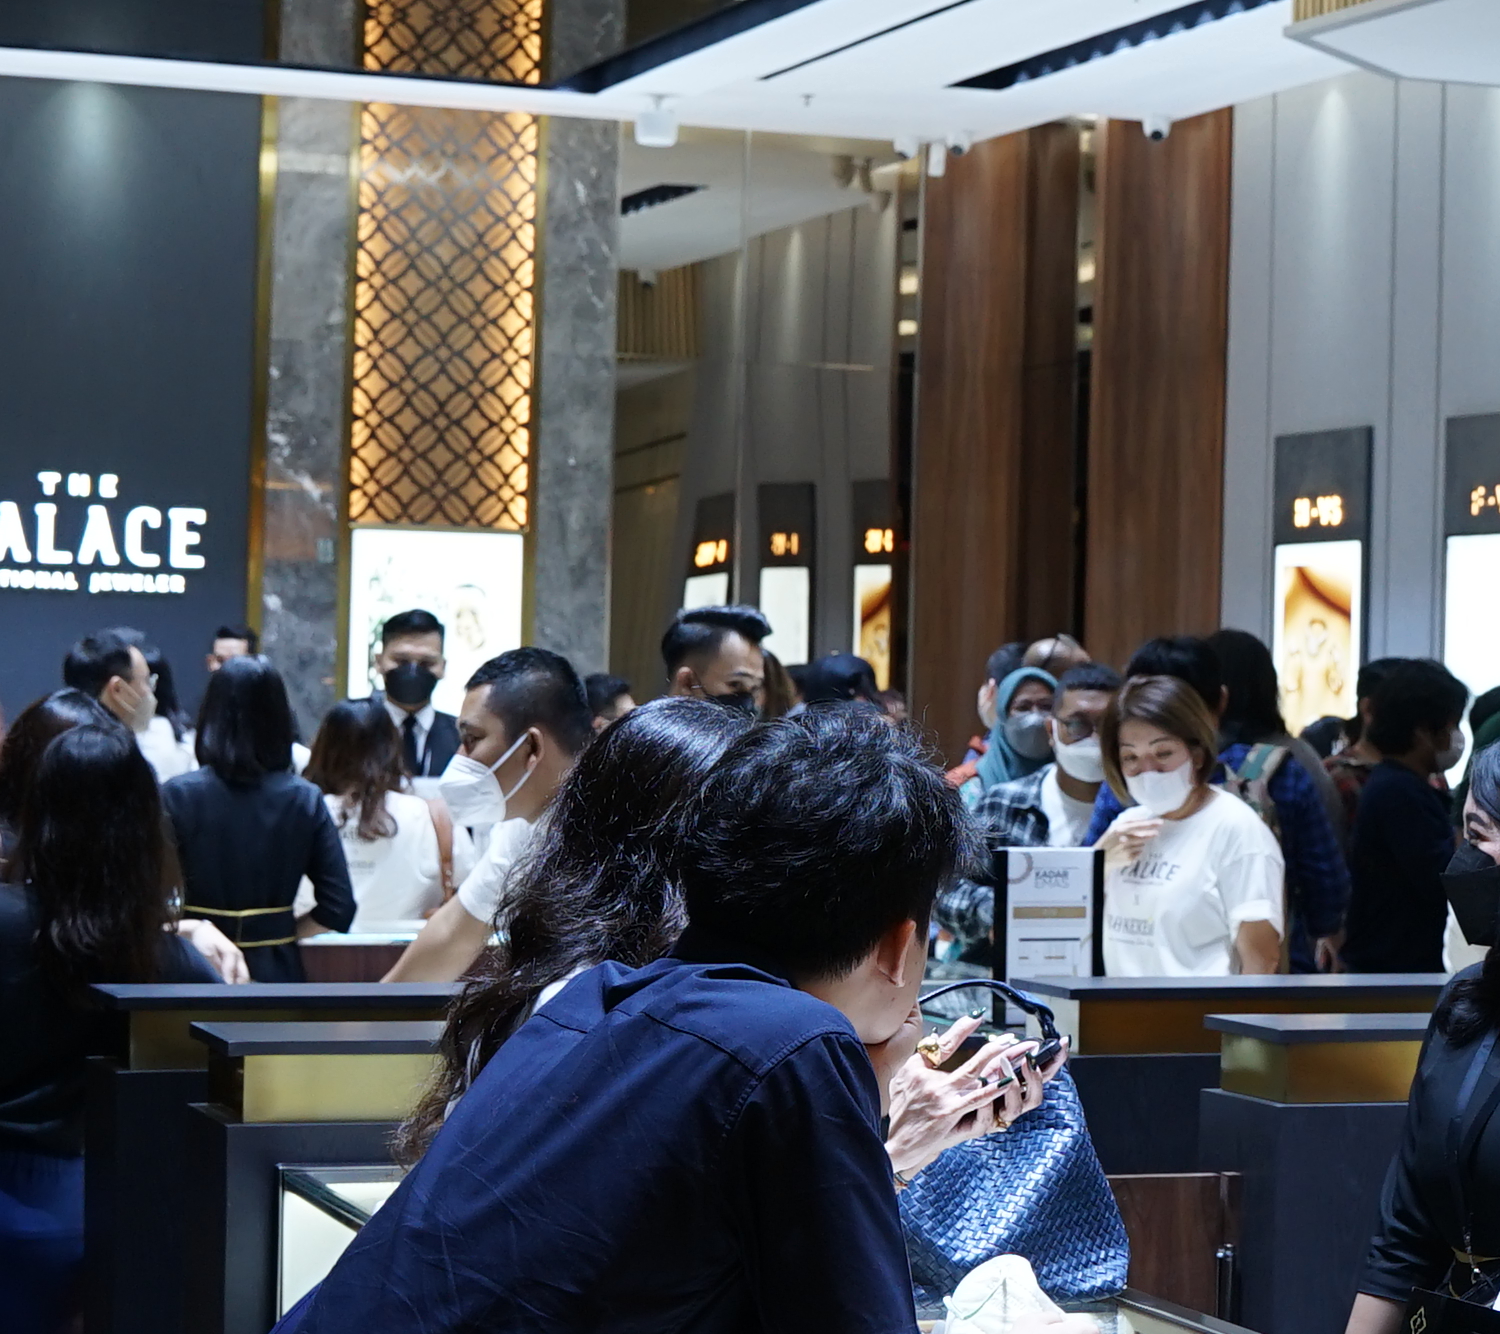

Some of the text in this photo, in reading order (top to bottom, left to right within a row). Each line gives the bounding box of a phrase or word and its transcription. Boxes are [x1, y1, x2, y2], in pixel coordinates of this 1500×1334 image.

[37, 471, 119, 498] THE
[88, 572, 186, 594] JEWELER
[1034, 870, 1070, 880] KADAR
